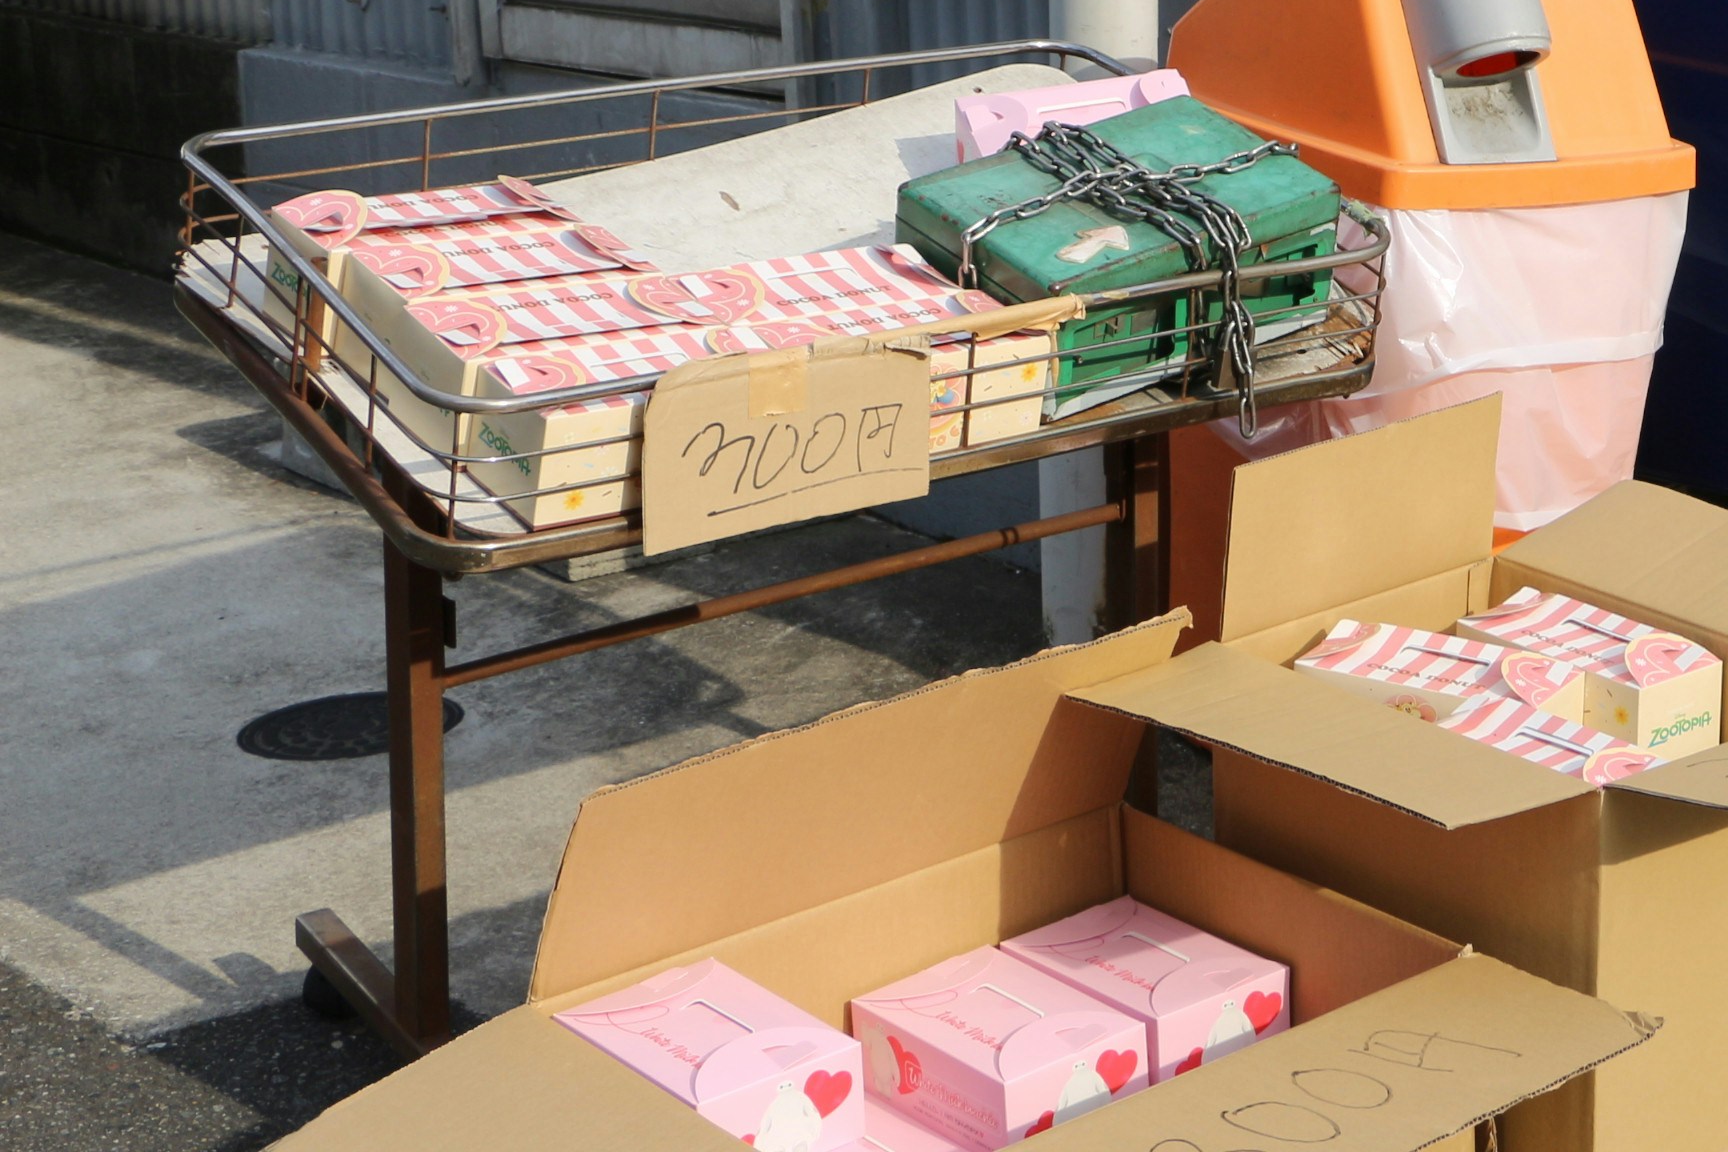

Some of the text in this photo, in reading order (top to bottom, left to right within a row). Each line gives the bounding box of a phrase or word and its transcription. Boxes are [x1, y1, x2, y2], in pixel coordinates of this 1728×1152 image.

[557, 291, 614, 305] COCOA
[776, 285, 892, 308] COCOA DONUT
[1521, 628, 1567, 649] COCOA
[1366, 661, 1486, 692] COCOA DONUT
[1648, 710, 1712, 748] ZOOTOPIA
